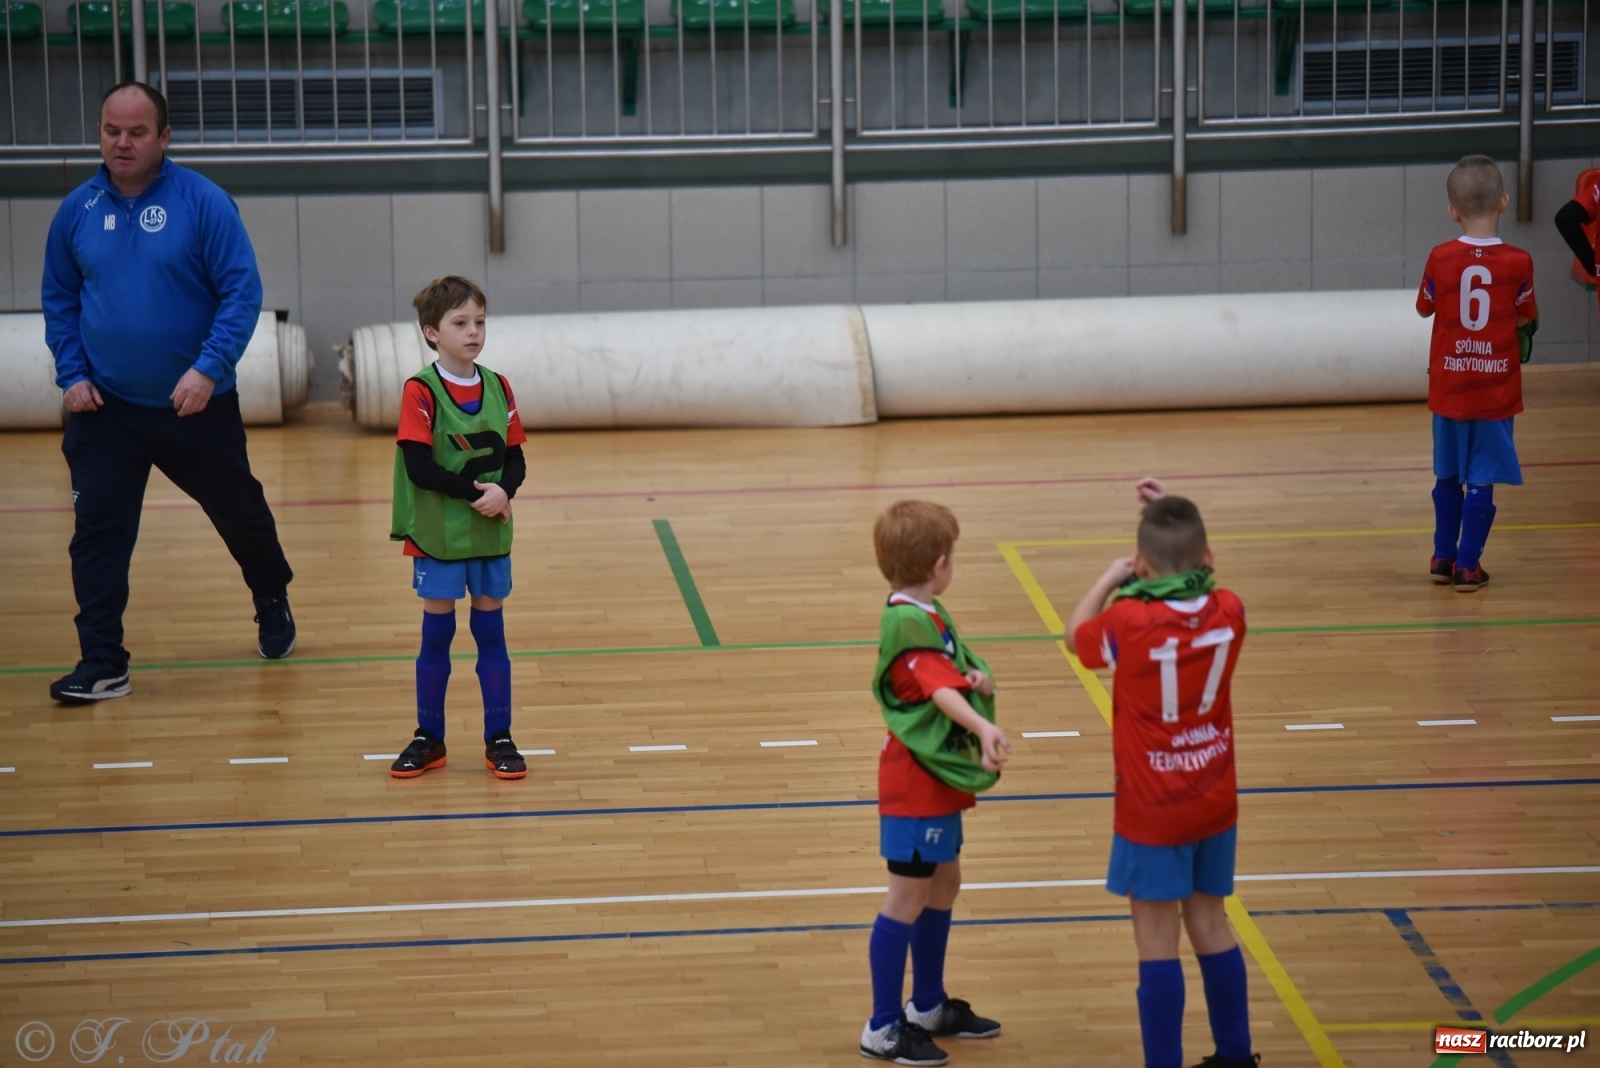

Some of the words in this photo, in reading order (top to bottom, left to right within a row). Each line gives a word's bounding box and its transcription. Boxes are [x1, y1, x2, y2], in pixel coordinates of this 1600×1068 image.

[103, 214, 116, 231] MB
[1460, 265, 1492, 331] 6
[1455, 337, 1493, 356] SPÓJNIA
[1149, 626, 1235, 724] 17
